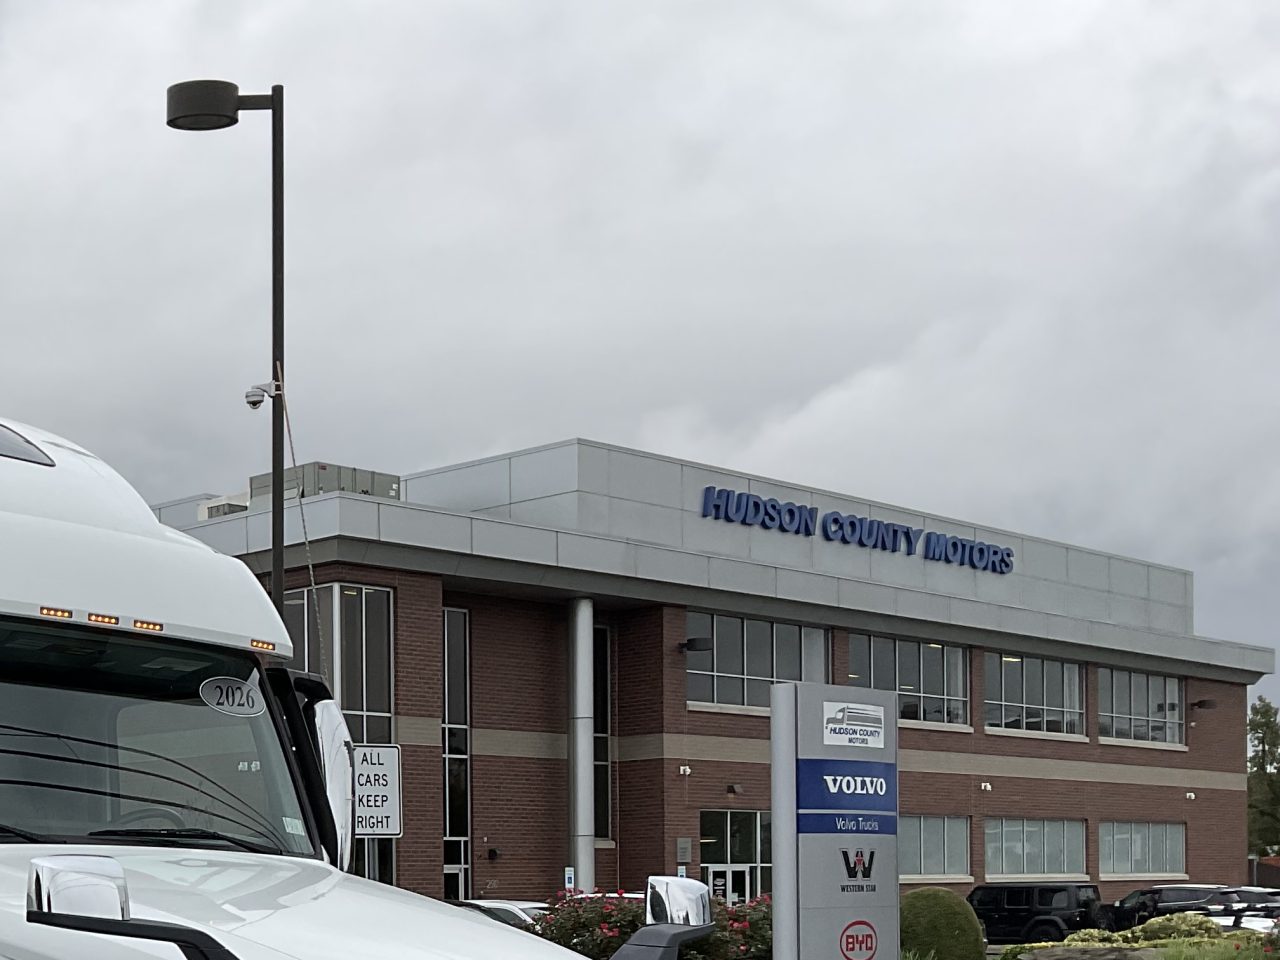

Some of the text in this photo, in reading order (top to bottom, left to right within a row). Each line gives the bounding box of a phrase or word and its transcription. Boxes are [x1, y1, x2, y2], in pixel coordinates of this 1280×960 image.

[702, 485, 1015, 575] HUDSON COUNTY MOTORS
[214, 685, 255, 709] 2026
[829, 727, 881, 738] HUDSON COUNTY
[361, 752, 384, 766] ALL
[357, 773, 388, 787] CARS
[823, 775, 886, 796] VOLVO
[358, 794, 389, 808] KEEP
[356, 816, 390, 829] RIGHT
[835, 817, 879, 831] Volvo Trucks
[840, 884, 865, 892] WESTERN
[845, 933, 873, 952] BYD
